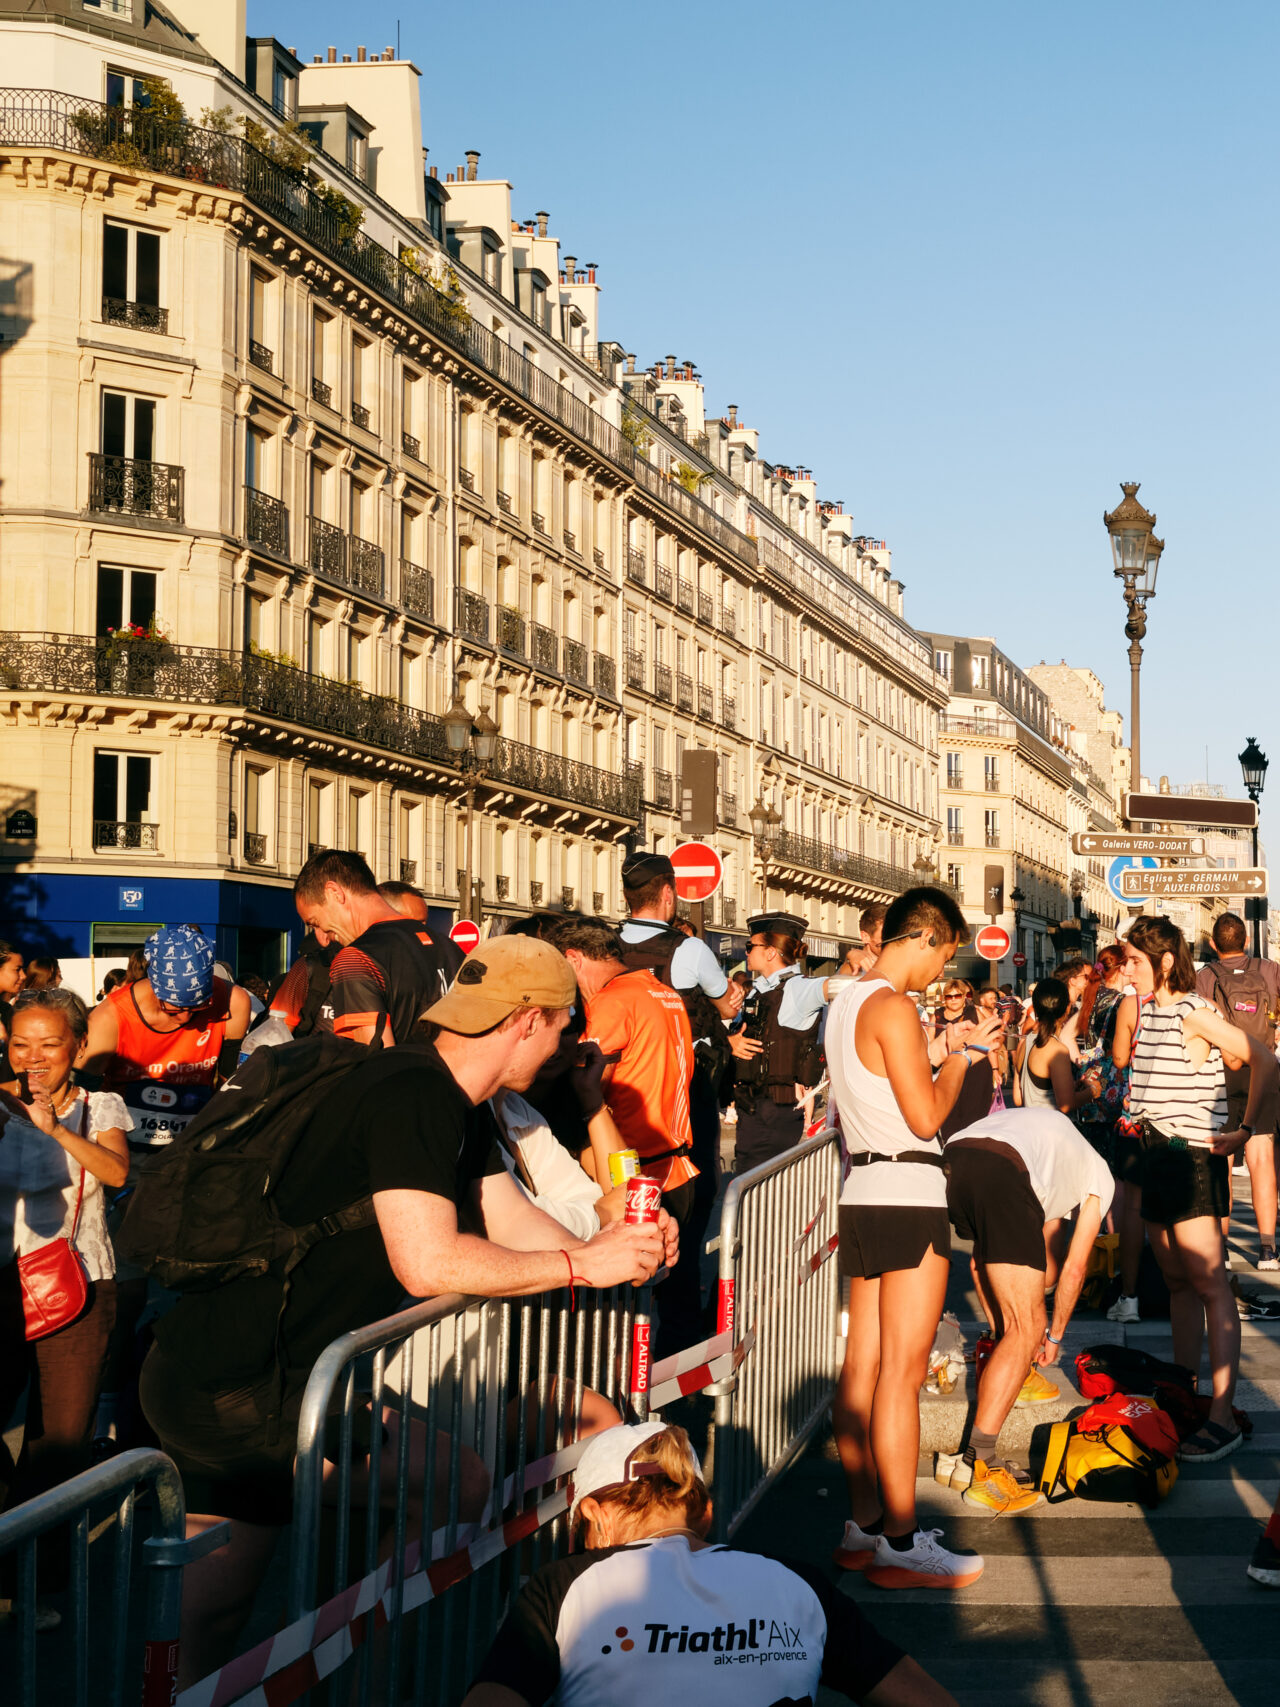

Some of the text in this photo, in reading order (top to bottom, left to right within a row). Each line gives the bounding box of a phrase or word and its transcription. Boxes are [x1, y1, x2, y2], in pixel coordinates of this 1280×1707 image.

[1102, 839, 1188, 851] Galerie VERO-DODAT
[1143, 873, 1174, 884] Eglise
[1193, 873, 1240, 883] GERMAIN
[1163, 884, 1221, 893] AUXERROIS
[122, 890, 142, 904] 150
[321, 1005, 334, 1020] Te
[165, 1055, 218, 1074] Orange
[726, 1296, 734, 1331] ALTRA
[638, 1343, 648, 1390] ALTRAD
[714, 1651, 808, 1666] aix-en-provence
